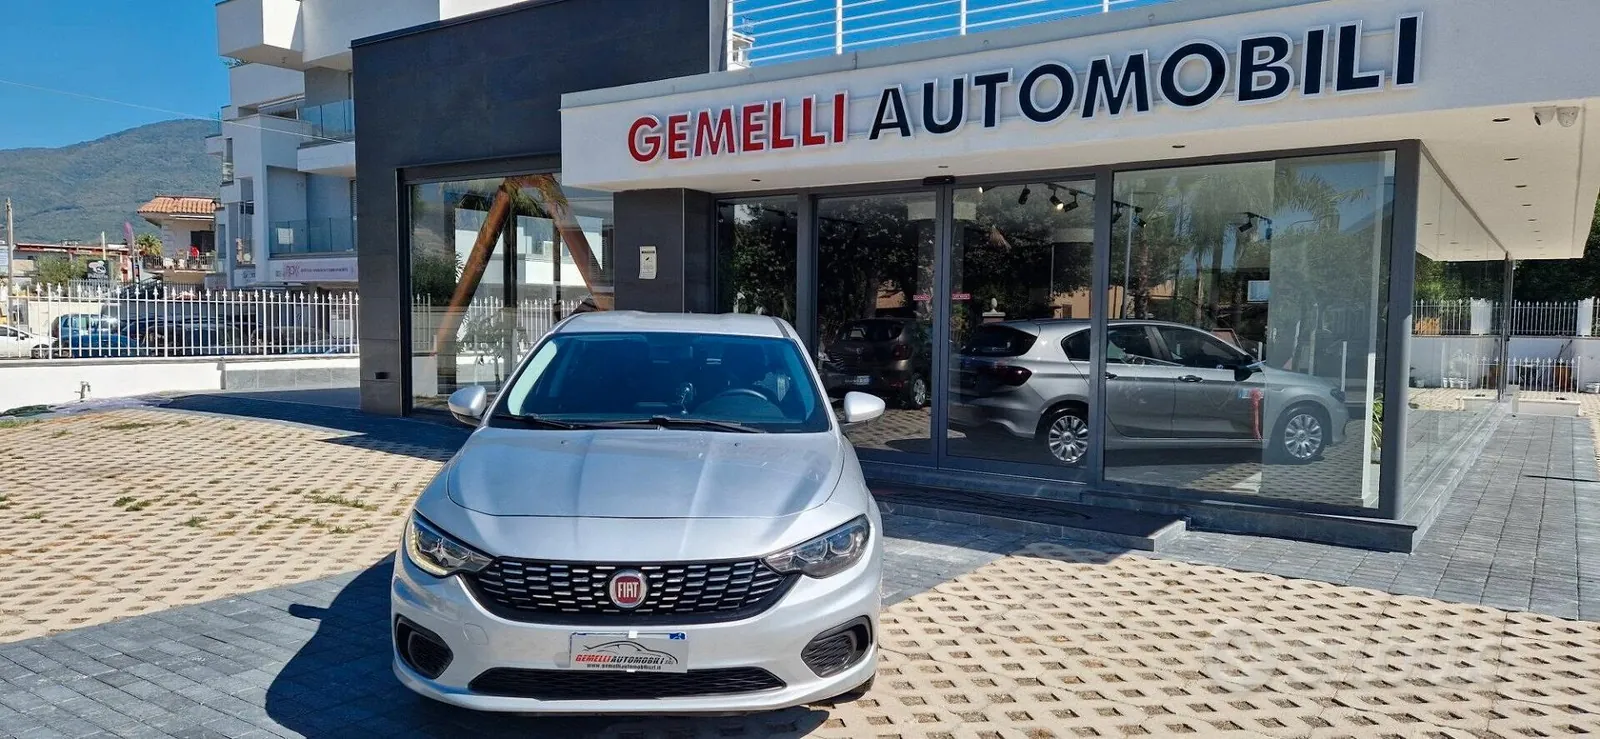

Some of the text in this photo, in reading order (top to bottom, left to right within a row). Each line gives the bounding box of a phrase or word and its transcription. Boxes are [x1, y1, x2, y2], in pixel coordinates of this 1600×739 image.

[627, 15, 1420, 163] GEMELLI AUTOMOBILI
[618, 581, 639, 598] FIAT
